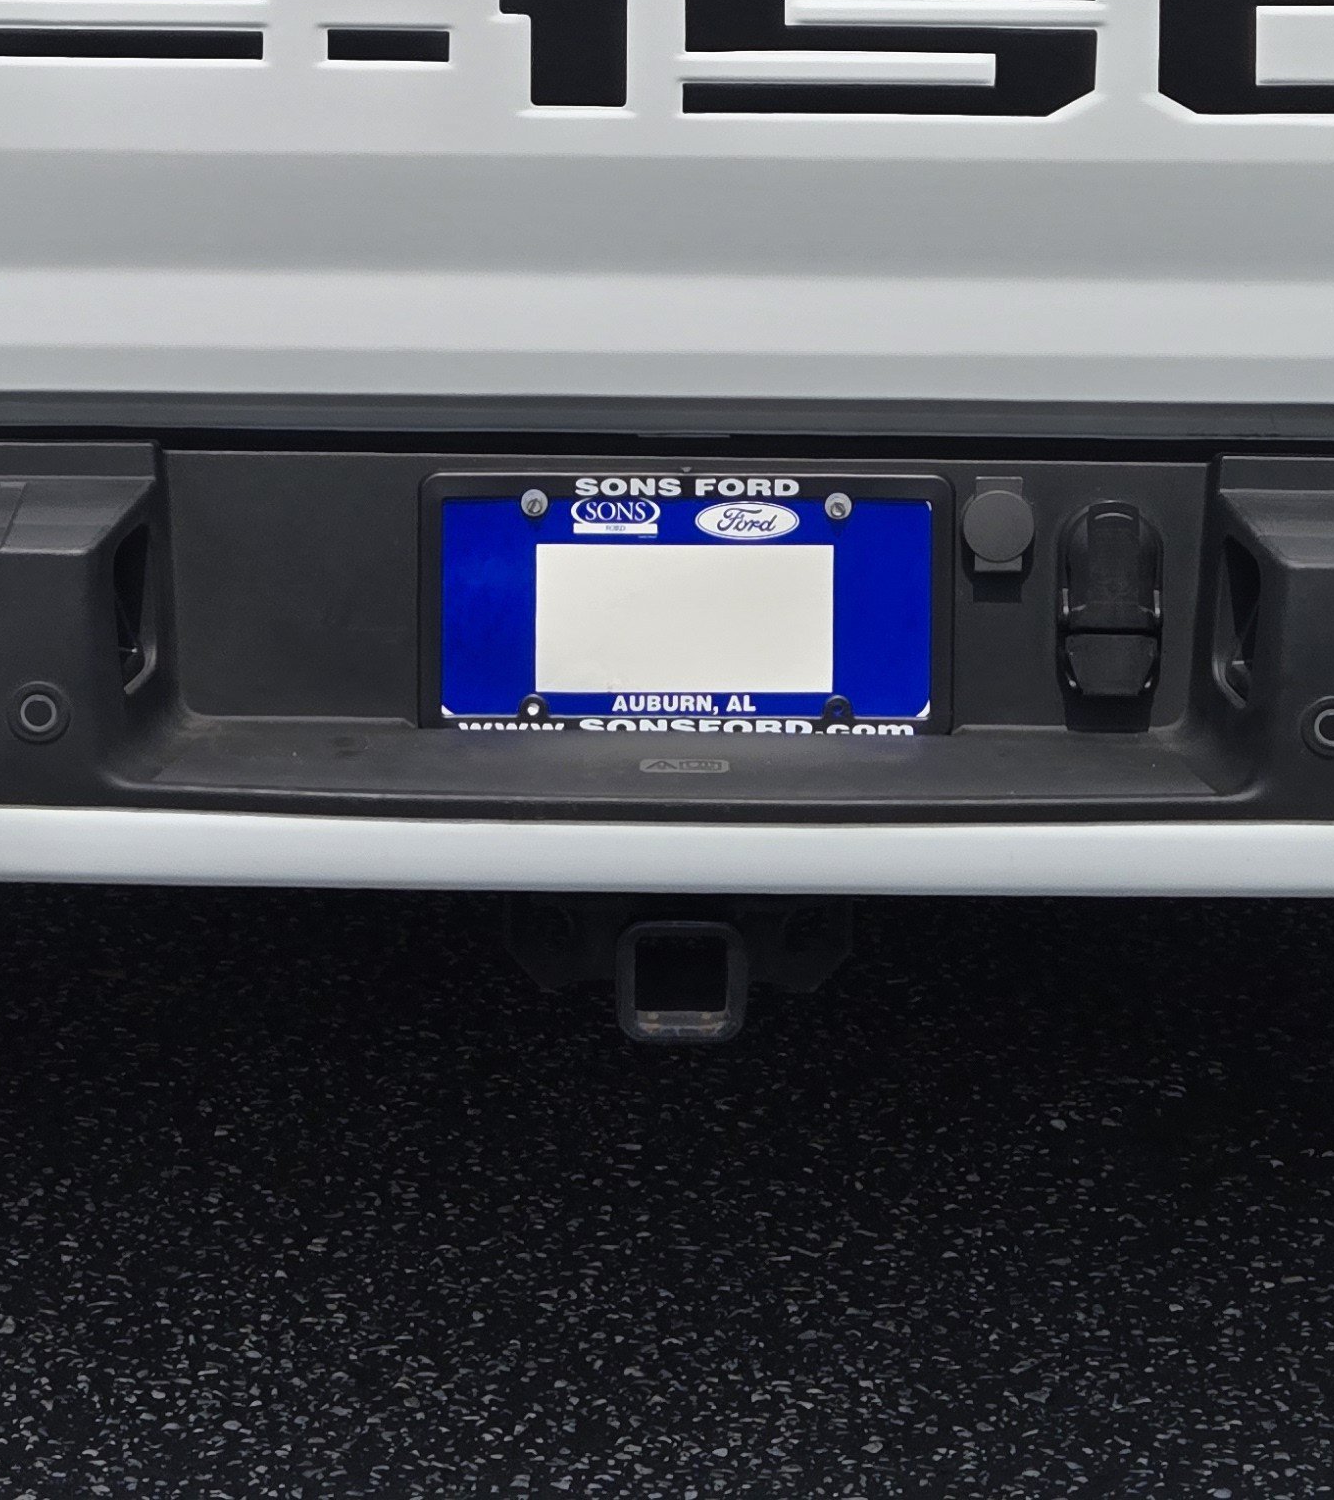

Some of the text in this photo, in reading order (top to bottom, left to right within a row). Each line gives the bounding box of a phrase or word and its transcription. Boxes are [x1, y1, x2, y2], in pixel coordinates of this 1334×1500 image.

[575, 478, 800, 497] SONS FORD
[585, 501, 647, 521] SONS
[717, 508, 778, 532] Ford
[612, 695, 757, 714] AUBURN, AL
[458, 718, 914, 736] wwwSONSFORD.com
